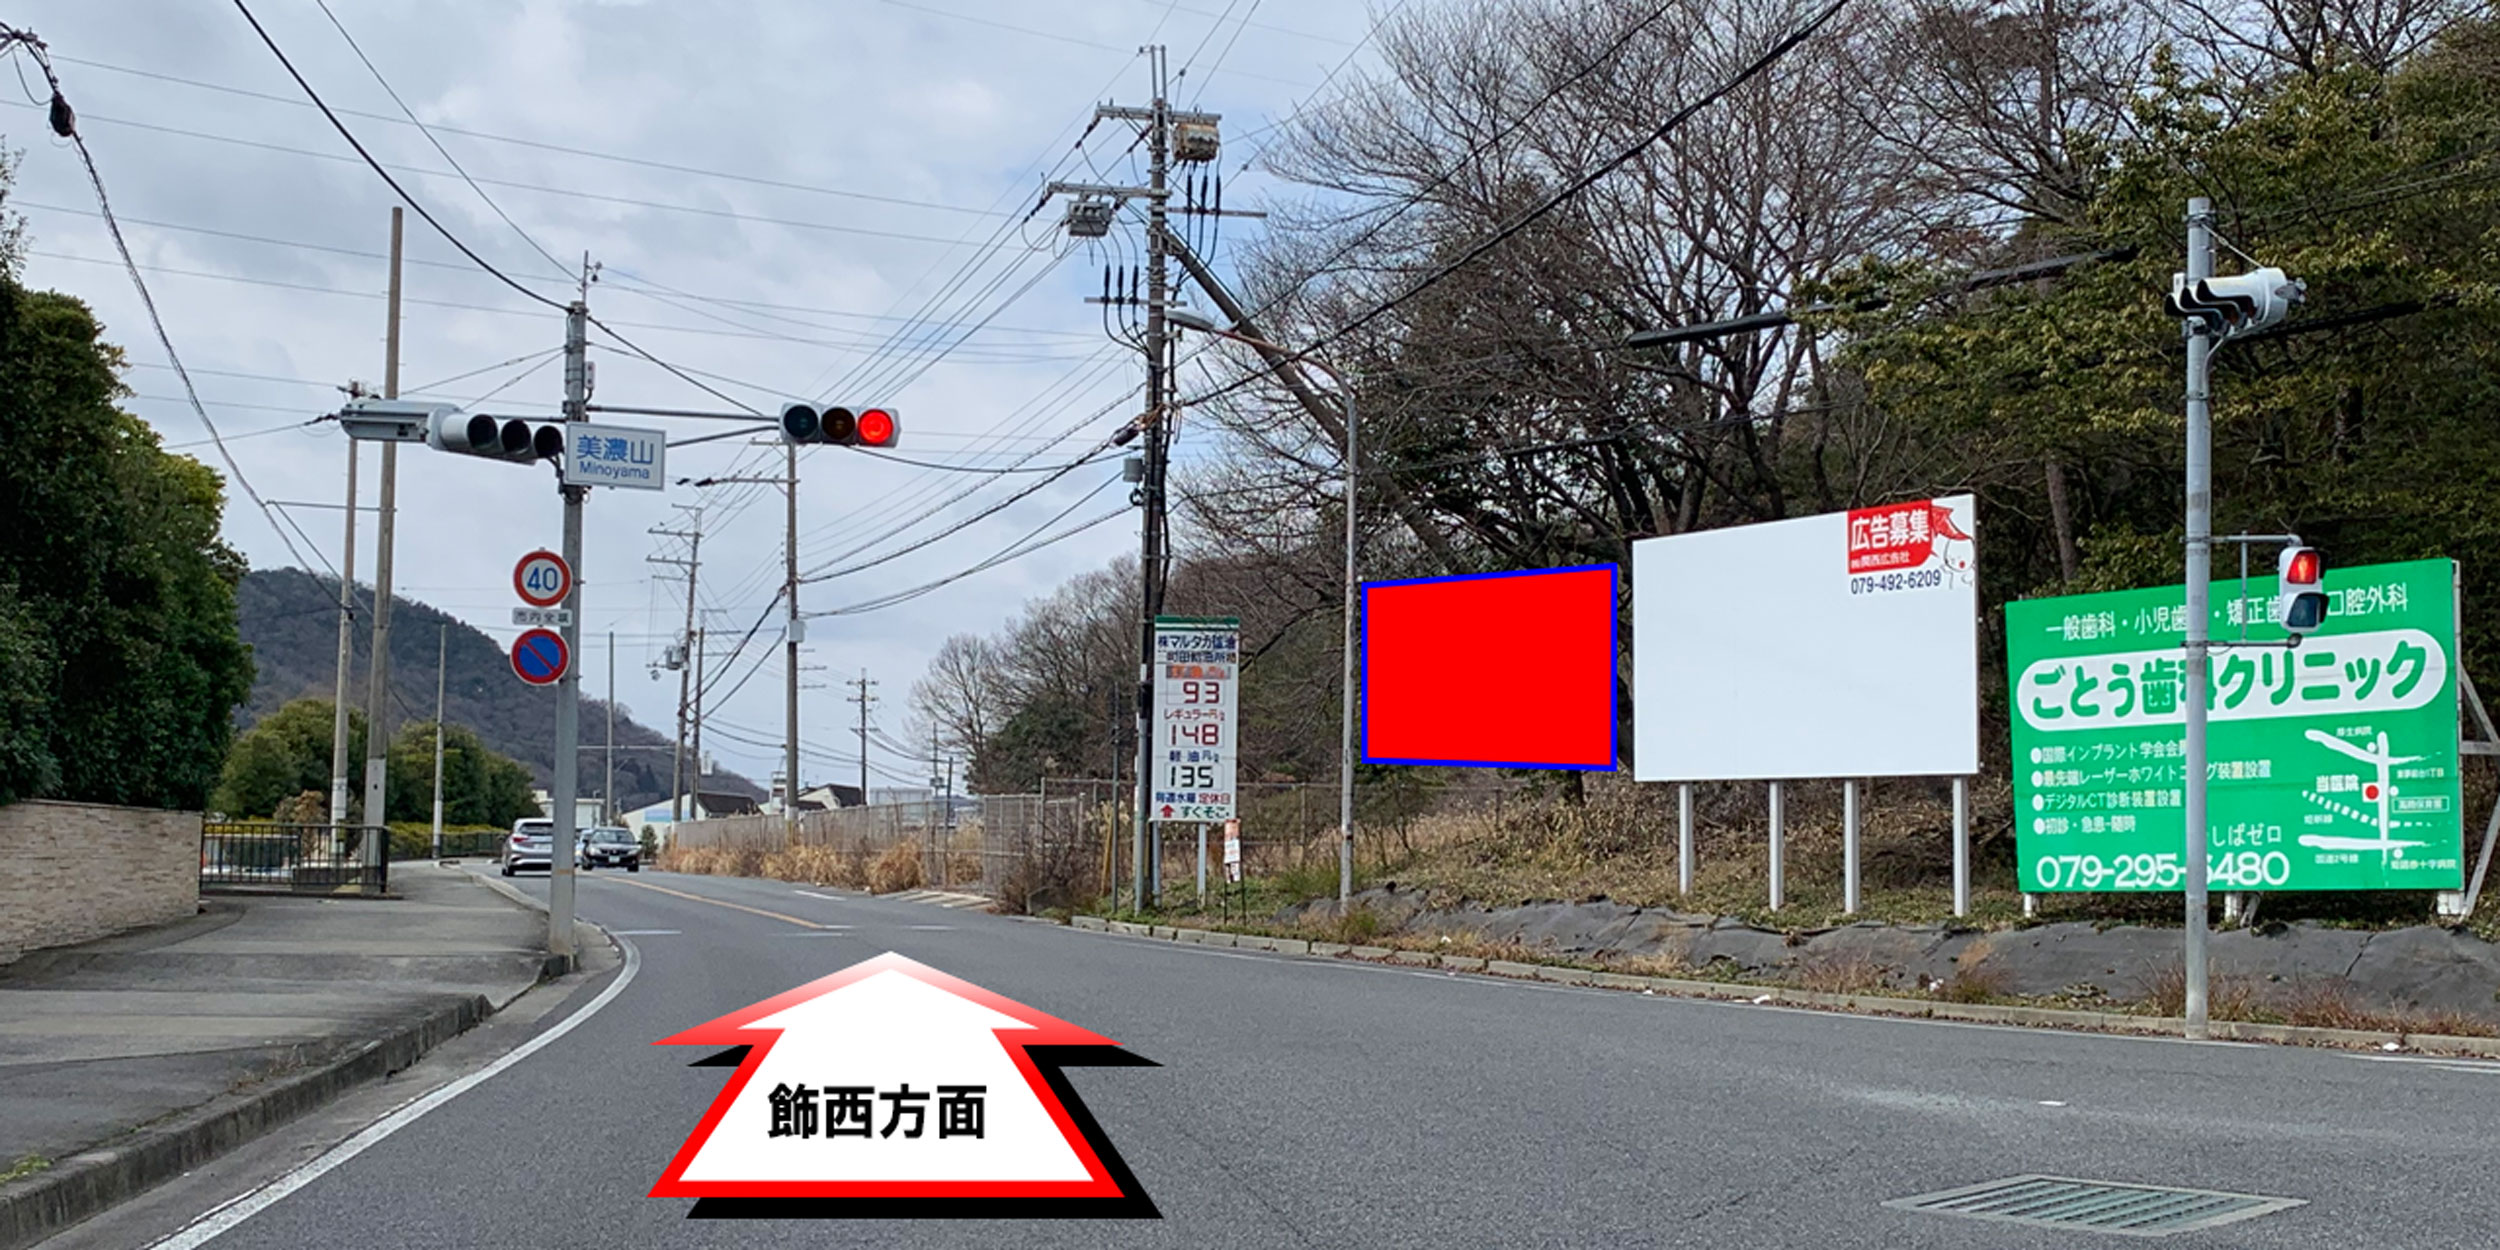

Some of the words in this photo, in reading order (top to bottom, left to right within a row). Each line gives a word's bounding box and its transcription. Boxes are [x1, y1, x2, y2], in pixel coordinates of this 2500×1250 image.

[576, 434, 654, 465] 美濃山
[580, 461, 650, 480] Minoyama
[1851, 508, 1930, 551] 広告募集
[527, 567, 558, 591] 40
[1851, 569, 1942, 595] 079-492-6209
[1183, 681, 1220, 704] 93
[1171, 723, 1220, 746] 148
[1170, 765, 1214, 788] 135
